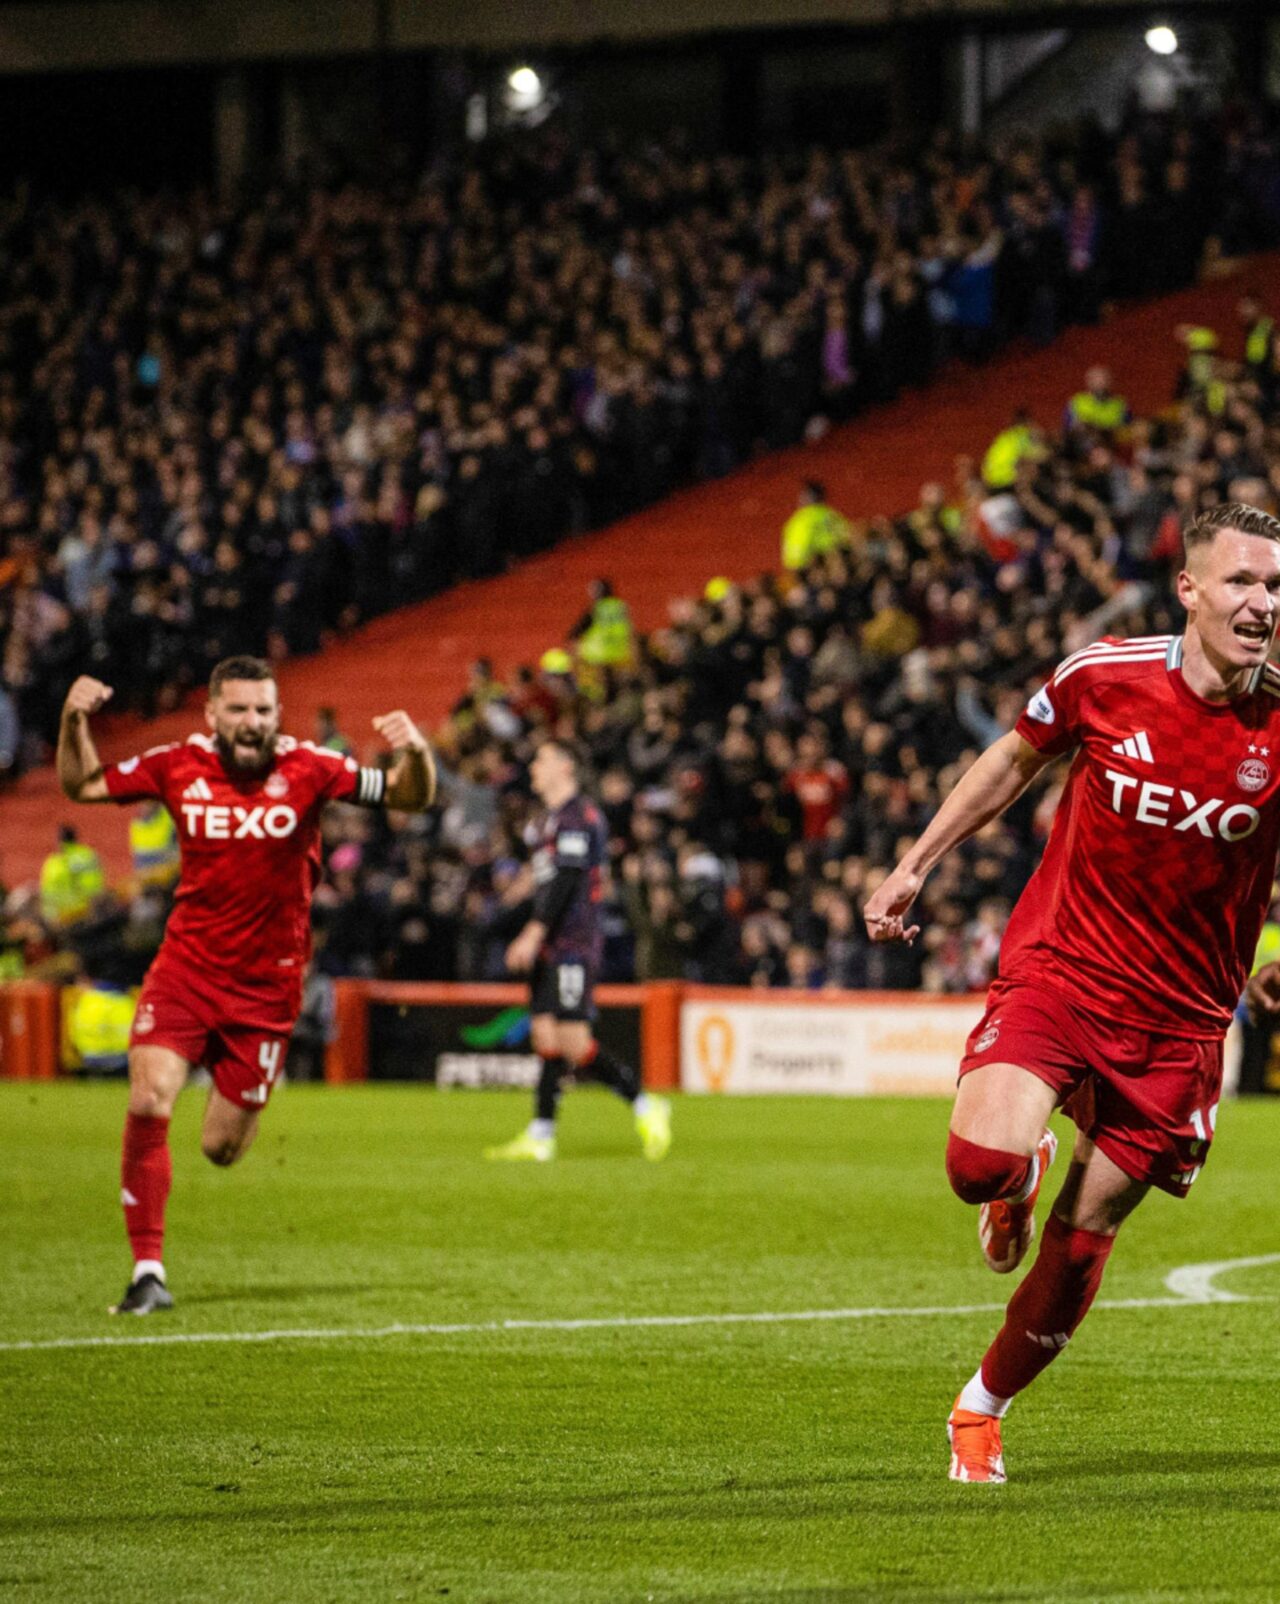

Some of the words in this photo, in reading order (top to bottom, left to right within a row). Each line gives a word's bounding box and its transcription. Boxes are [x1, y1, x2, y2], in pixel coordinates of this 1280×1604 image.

[182, 804, 298, 839] TEXO
[1105, 769, 1260, 842] TEXO
[259, 1041, 281, 1083] 4
